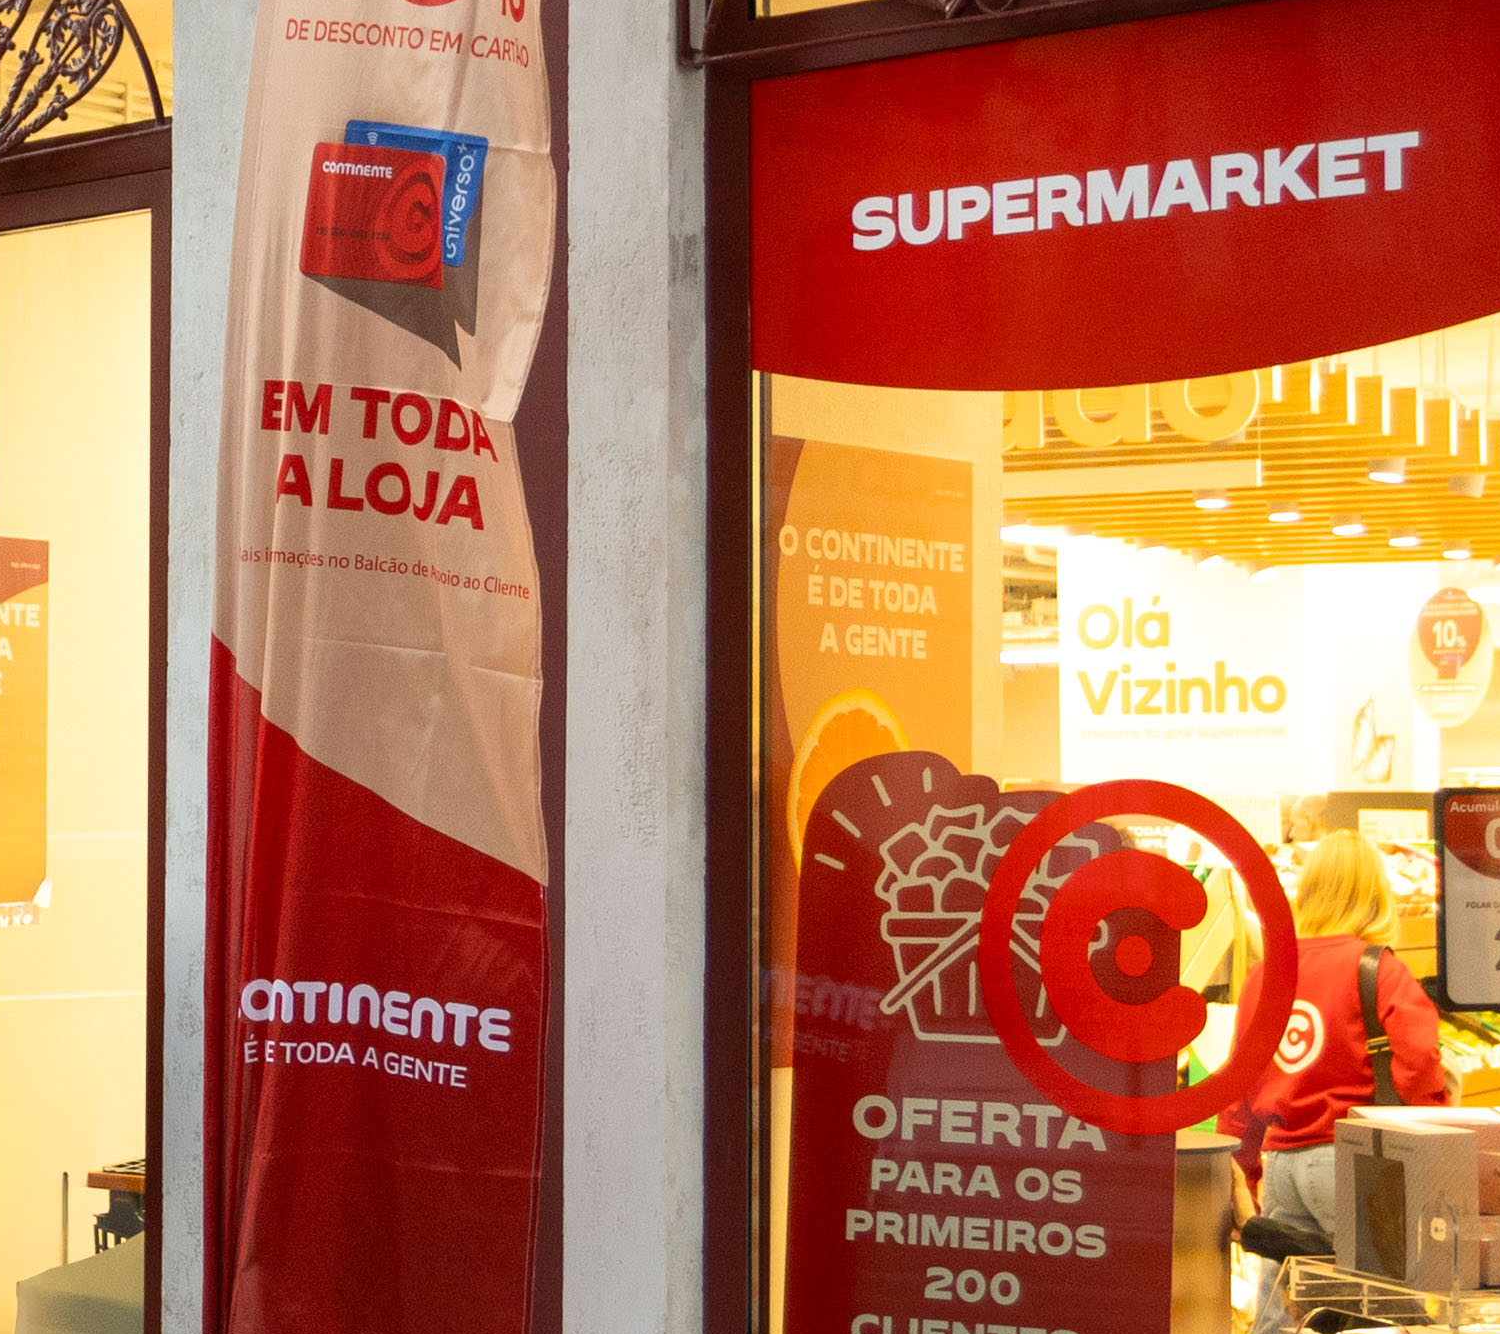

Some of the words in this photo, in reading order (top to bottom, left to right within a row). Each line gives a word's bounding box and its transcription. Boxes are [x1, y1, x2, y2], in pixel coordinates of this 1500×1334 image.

[285, 18, 309, 41] DE
[313, 19, 425, 51] DESCONTO
[429, 29, 464, 55] EM
[322, 160, 393, 179] CONTINENTE
[851, 130, 1421, 252] SUPERMARKET
[260, 379, 332, 436] EM
[350, 385, 500, 464] TODA
[274, 453, 314, 507] A
[326, 457, 486, 531] LOJA
[240, 546, 261, 563] ais
[328, 554, 350, 569] no
[354, 554, 409, 575] Balcão
[411, 559, 429, 578] de
[463, 576, 481, 591] ao
[483, 575, 531, 600] Cliente
[778, 524, 799, 557] O
[805, 527, 965, 573] CONTINENTE
[807, 563, 824, 606] É
[829, 575, 864, 610] DE
[868, 579, 939, 616] TODA
[819, 622, 839, 655] A
[844, 623, 928, 660] GENTE
[1076, 594, 1171, 651] Olá
[1075, 660, 1288, 716] Vizinho
[238, 978, 512, 1053] ONTINENTE
[244, 1033, 259, 1064] É
[279, 1040, 356, 1065] TODA
[361, 1046, 380, 1070] A
[383, 1051, 468, 1089] GENTE
[851, 1094, 1108, 1153] OFERTA
[870, 1158, 1001, 1199] PARA
[1014, 1167, 1084, 1204] OS
[845, 1208, 1108, 1259] PRIMEIROS
[923, 1266, 1022, 1306] 200
